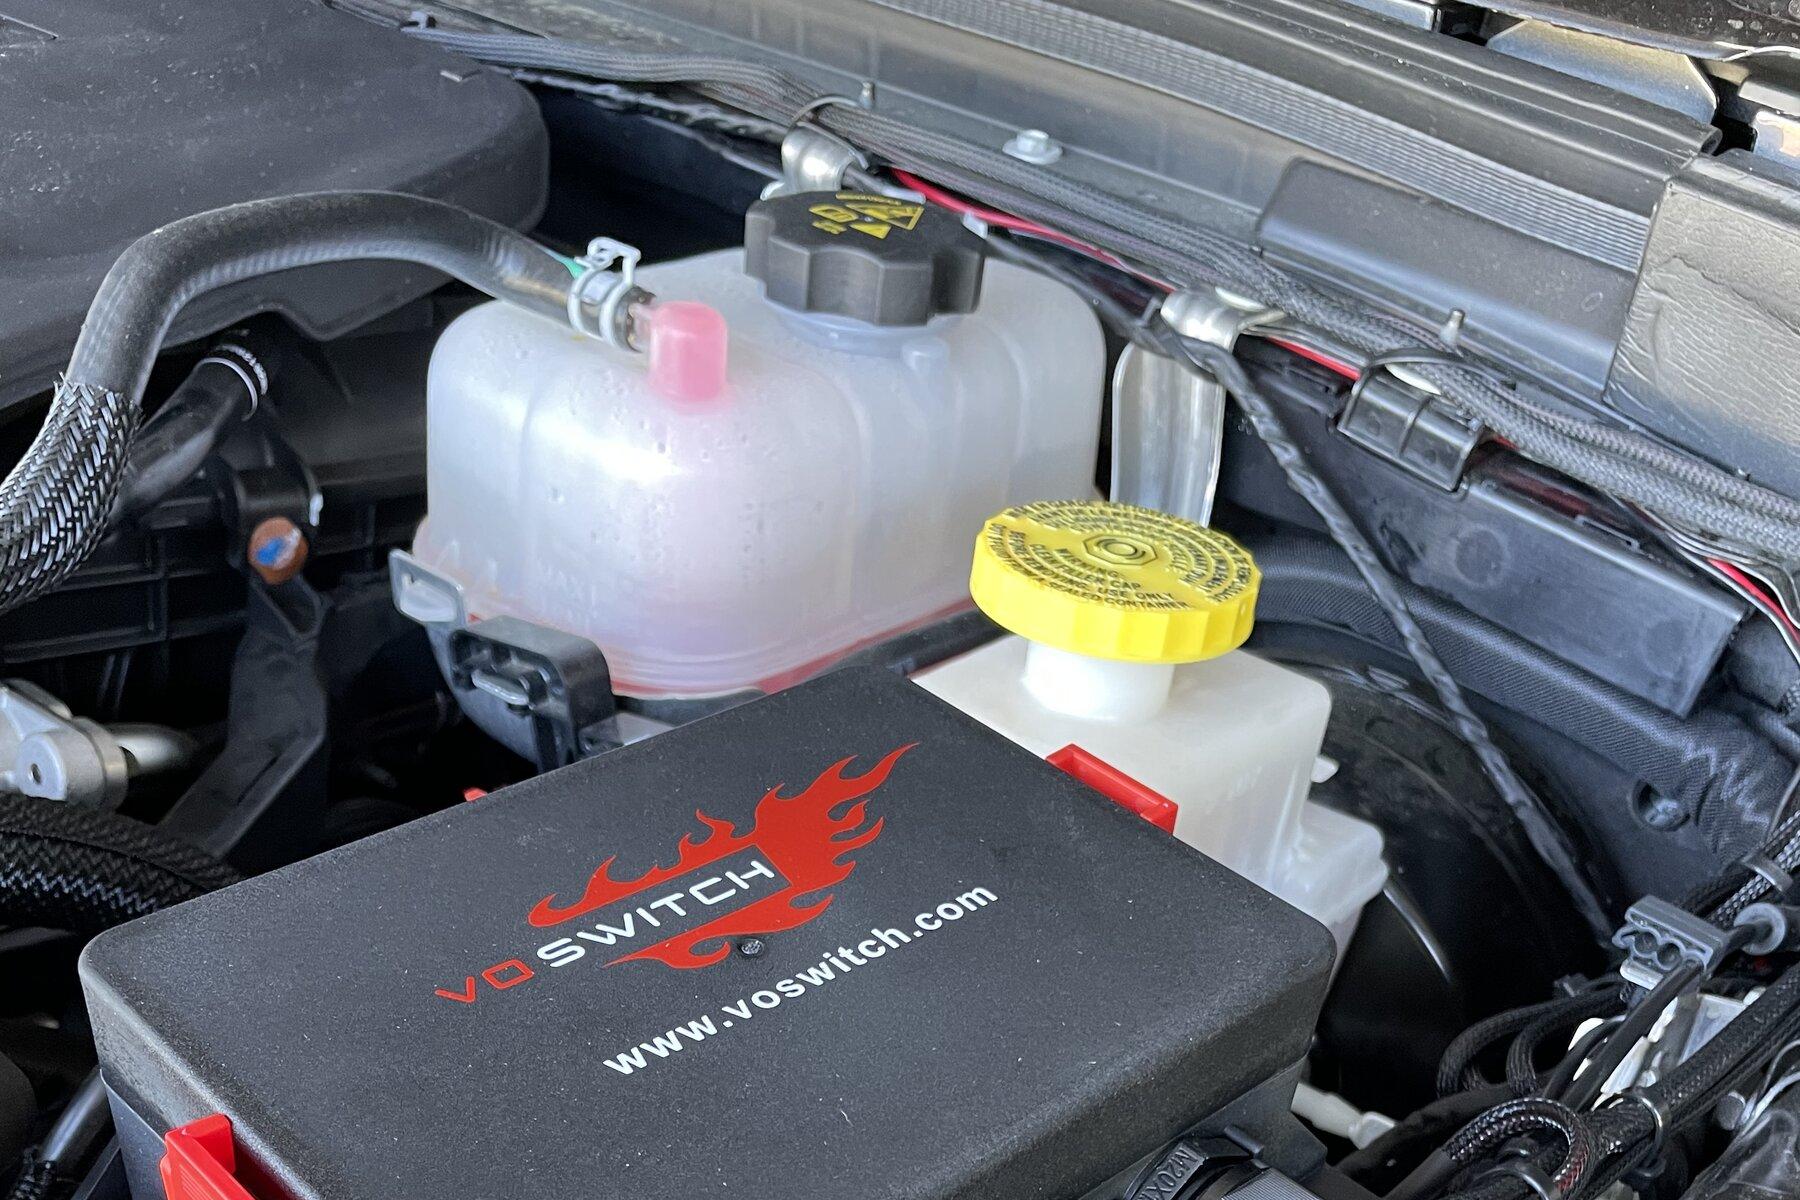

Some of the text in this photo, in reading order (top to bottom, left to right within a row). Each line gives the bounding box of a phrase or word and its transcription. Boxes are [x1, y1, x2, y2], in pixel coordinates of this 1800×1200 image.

[1110, 579, 1141, 590] CAP
[1097, 587, 1129, 599] USE
[1135, 592, 1175, 601] ONLY
[1104, 596, 1190, 609] CONTAINER
[603, 883, 998, 1076] www.voswitch.com
